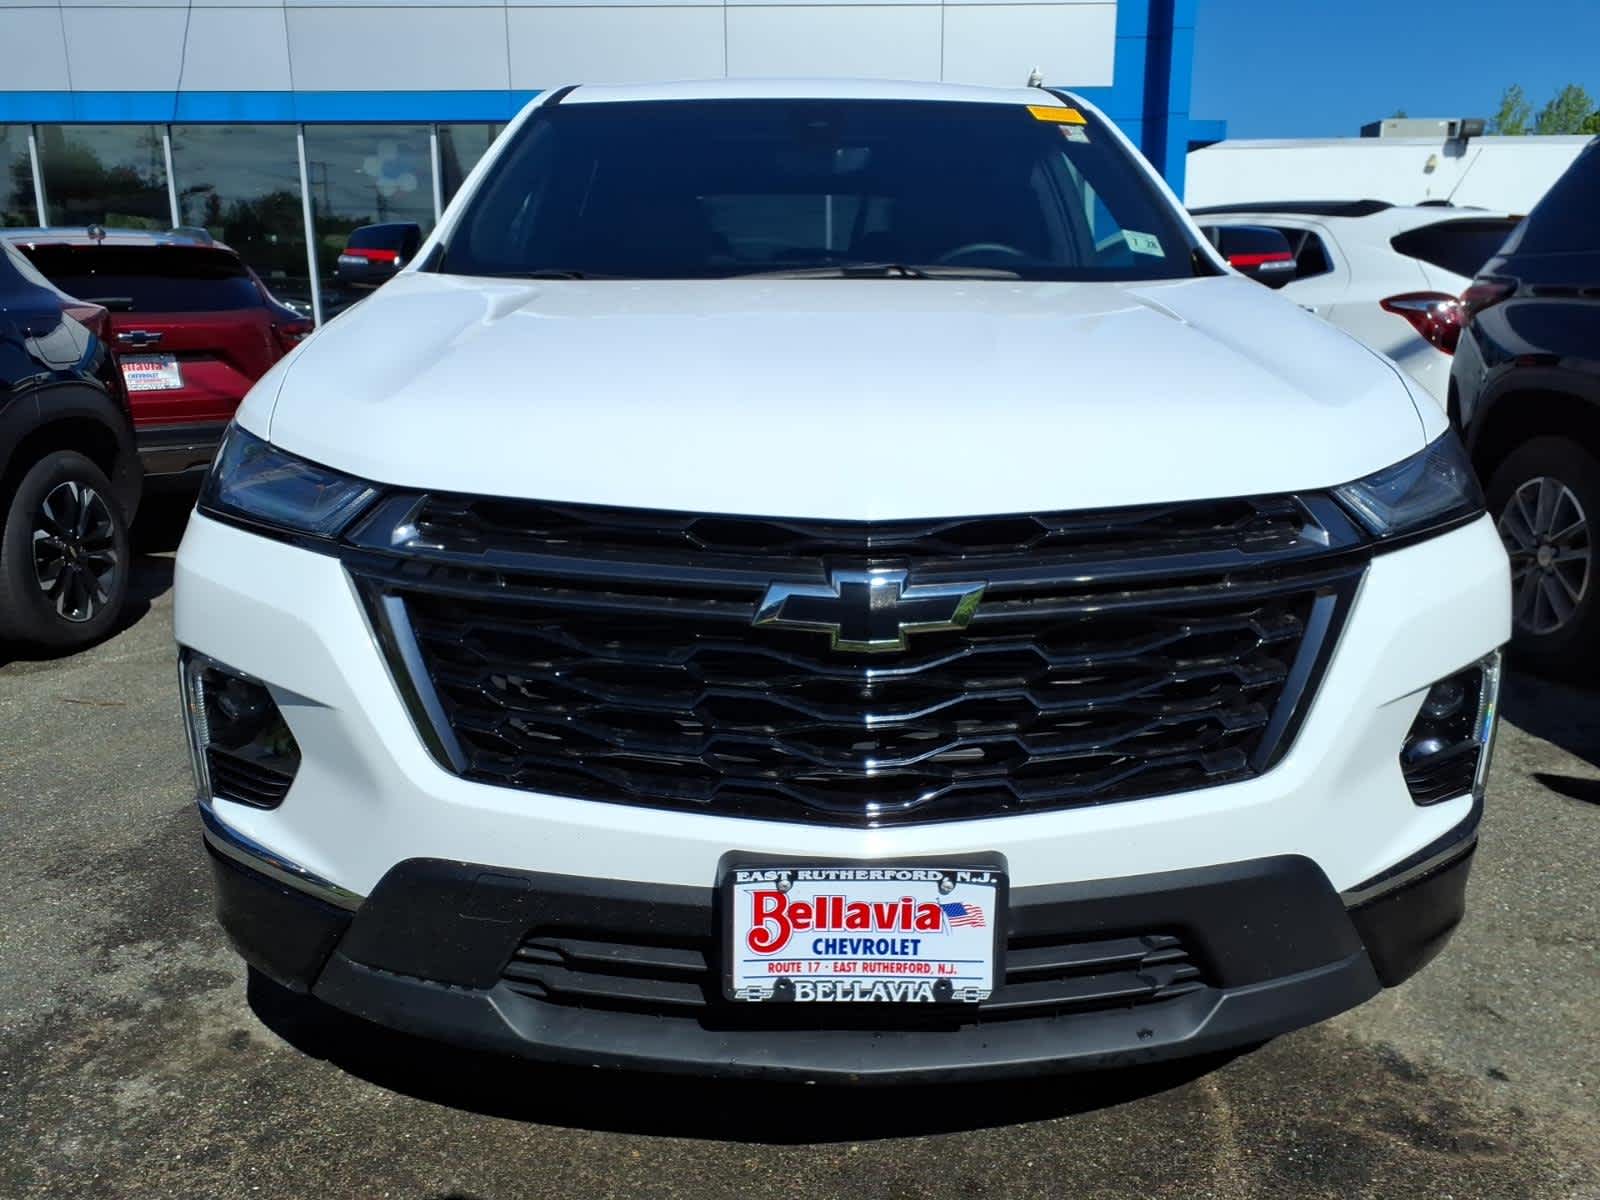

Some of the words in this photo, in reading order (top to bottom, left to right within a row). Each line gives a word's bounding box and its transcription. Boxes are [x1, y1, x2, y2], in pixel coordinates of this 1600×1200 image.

[736, 870, 792, 882] EAST
[797, 870, 949, 882] RUTHERFORD,
[956, 871, 998, 883] N.J.
[747, 889, 943, 955] Bellavia
[812, 938, 921, 956] CHEVROLET
[768, 962, 802, 973] ROUTE
[808, 962, 821, 973] 17
[832, 962, 857, 973] EAST
[862, 962, 934, 975] RUTHERFORD,
[938, 963, 957, 975] N.J.
[793, 980, 936, 1002] BELLAVIA
